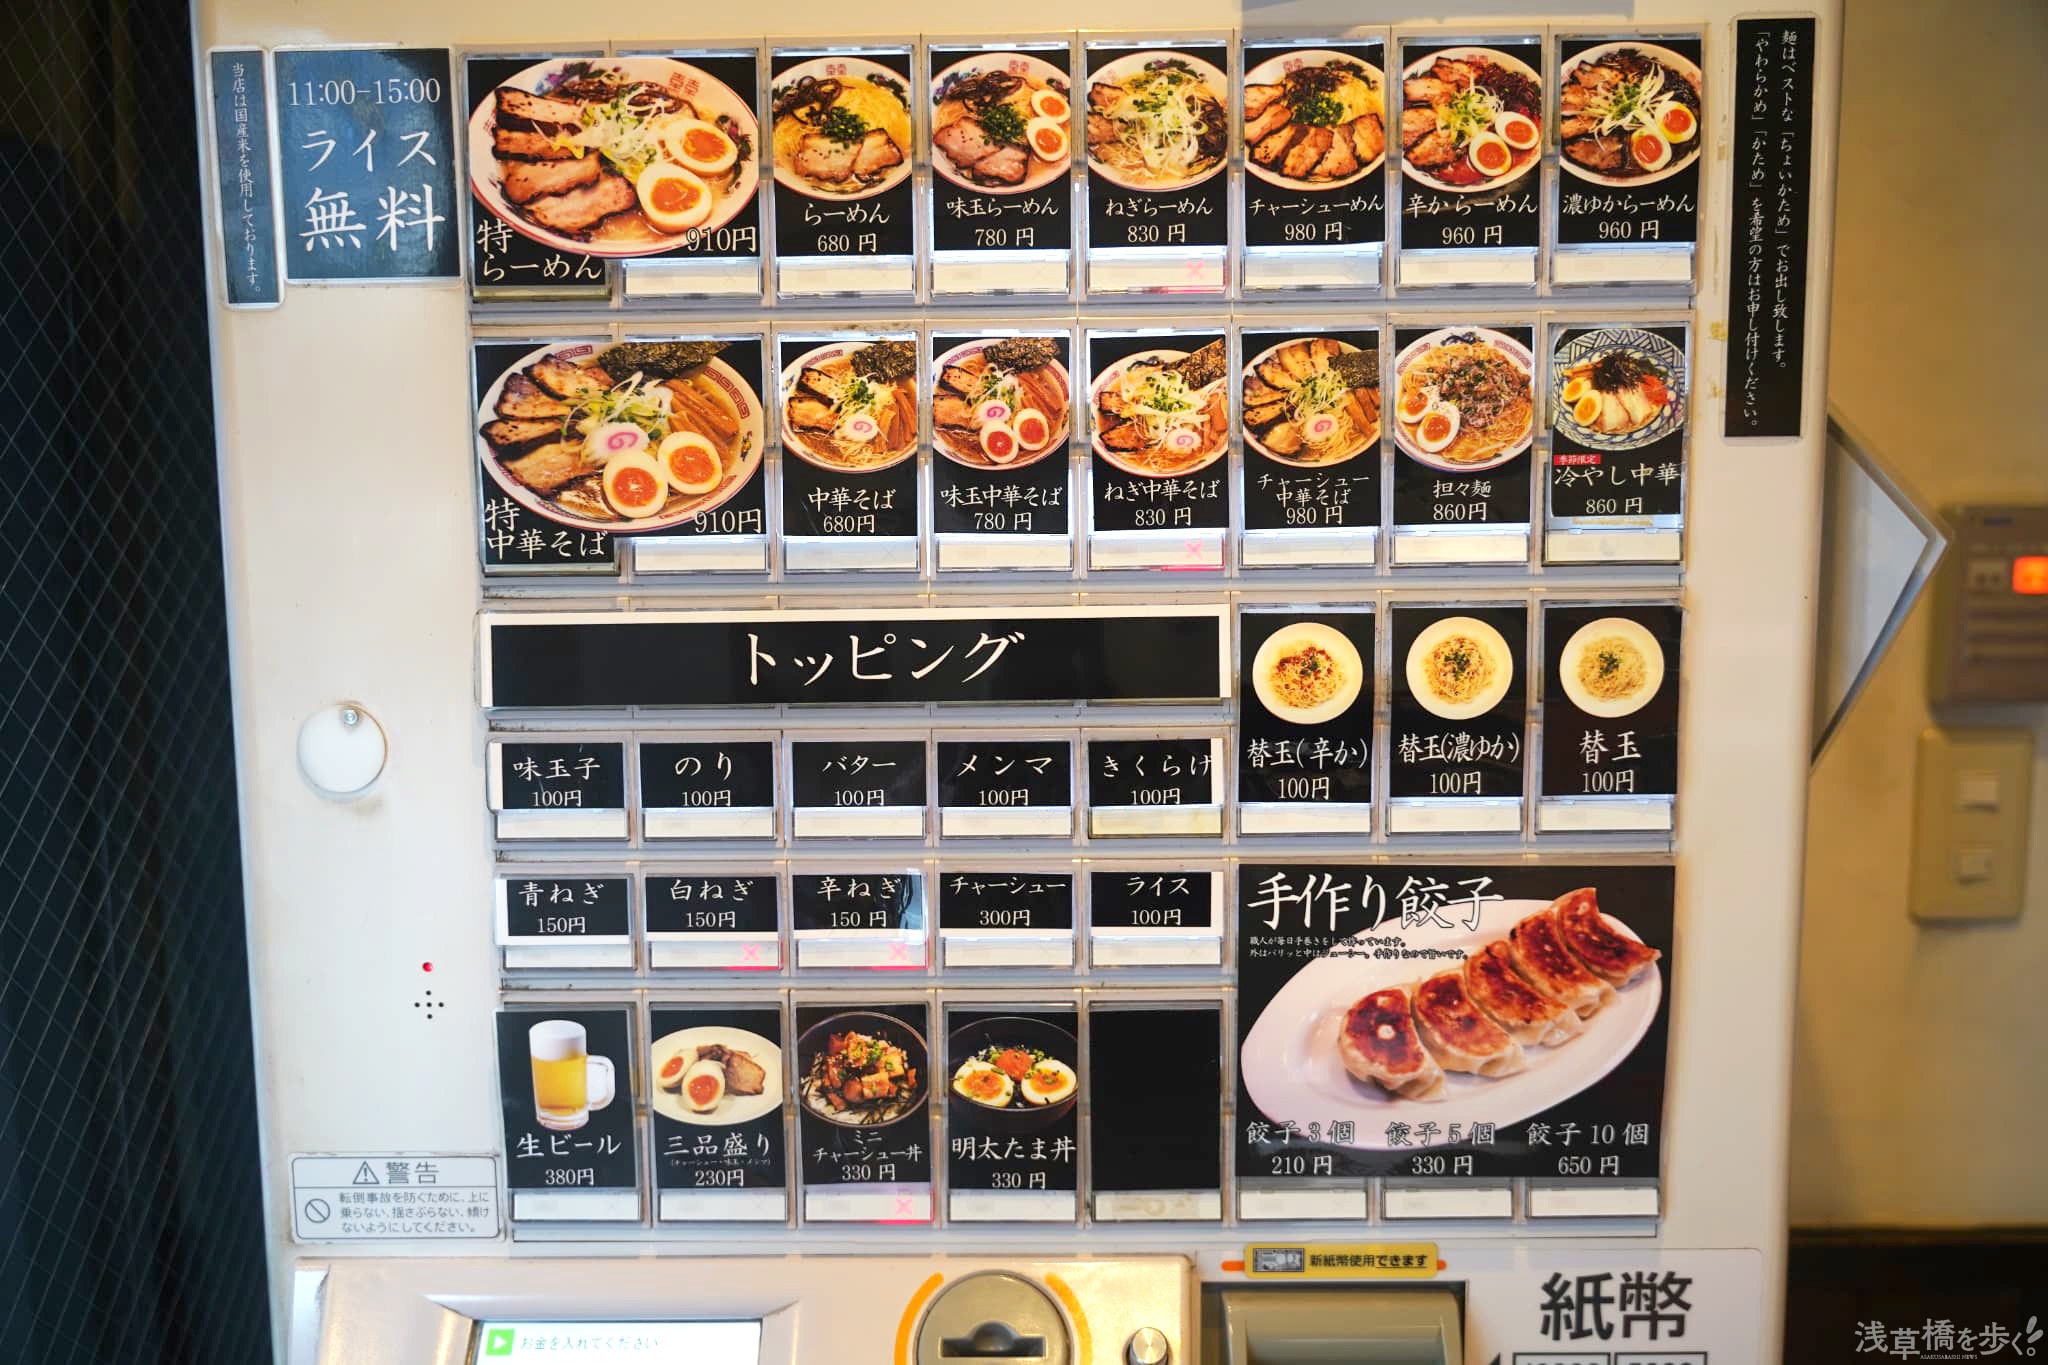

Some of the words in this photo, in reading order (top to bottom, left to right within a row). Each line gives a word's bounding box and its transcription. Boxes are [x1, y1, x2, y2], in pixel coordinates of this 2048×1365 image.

[289, 77, 441, 106] 11:00-15:00
[300, 129, 437, 172] ライス
[232, 62, 261, 292] 当店は国産米を使用しております。
[804, 203, 890, 224] らーめん
[946, 197, 1060, 217] 味玉らーめん
[1105, 197, 1214, 217] ねぎらーめん
[1249, 195, 1385, 217] チャーシューめん
[1407, 193, 1538, 218] 辛からーめん
[1562, 194, 1696, 214] 濃ゆからーめん
[300, 184, 446, 252] 無料
[476, 219, 509, 254] 特
[686, 227, 757, 253] 910円
[482, 254, 603, 281] らーめん
[1257, 472, 1369, 490] チャーシュー
[1554, 462, 1681, 488] 冷やし中華
[807, 487, 896, 513] 中華そば
[940, 484, 1063, 509] 味玉中華そば
[1104, 478, 1220, 502] ねぎ中華そば
[1276, 486, 1352, 508] 中華そば
[1432, 478, 1492, 499] 担々麺
[484, 497, 520, 531] 特
[694, 508, 762, 534] 910円
[1433, 502, 1487, 522] 860円
[823, 514, 875, 534] 680円
[486, 529, 608, 560] 中華そば
[748, 631, 1024, 686] トッピング
[1247, 737, 1369, 770] 替玉(辛か)
[1398, 732, 1521, 763] 替玉(濃ゆか)
[1579, 730, 1642, 763] 替玉
[513, 756, 601, 780] 味玉子
[674, 752, 733, 781] のり
[822, 755, 897, 774] バター
[957, 754, 1053, 777] メンマ
[1103, 755, 1213, 778] きくらげ
[1278, 777, 1329, 800] 100円
[1430, 772, 1481, 795] 100円
[1582, 769, 1634, 793] 100円
[532, 790, 582, 807] 100円
[682, 790, 731, 807] 100円
[835, 789, 885, 806] 100円
[979, 789, 1029, 806] 100円
[1131, 788, 1181, 805] 100円
[518, 882, 604, 907] 青ねぎ
[670, 879, 754, 902] 白ねぎ
[816, 876, 901, 902] 辛ねぎ
[950, 878, 1067, 896] チャーシュー
[1126, 877, 1190, 896] ライス
[1247, 872, 1504, 932] 手作り餃子
[537, 916, 586, 934] 150円
[686, 911, 736, 929] 150円
[831, 910, 887, 928] 150円
[979, 910, 1030, 927] 300円
[1131, 909, 1182, 926] 100円
[516, 1133, 622, 1158] 生ビール
[663, 1134, 770, 1158] 三品盛り
[852, 1129, 882, 1143] ミニ
[812, 1143, 923, 1164] チャーシュー丼
[952, 1136, 1076, 1162] 明太たま丼
[386, 1161, 440, 1185] 警告
[545, 1168, 595, 1186] 380円
[695, 1168, 745, 1187] 230円
[342, 1222, 476, 1233] ないようにしてください。
[1310, 1254, 1428, 1268] 新紙幣使用できます
[1540, 1271, 1693, 1341] 紙幣
[520, 1336, 660, 1350] お金を入れてください
